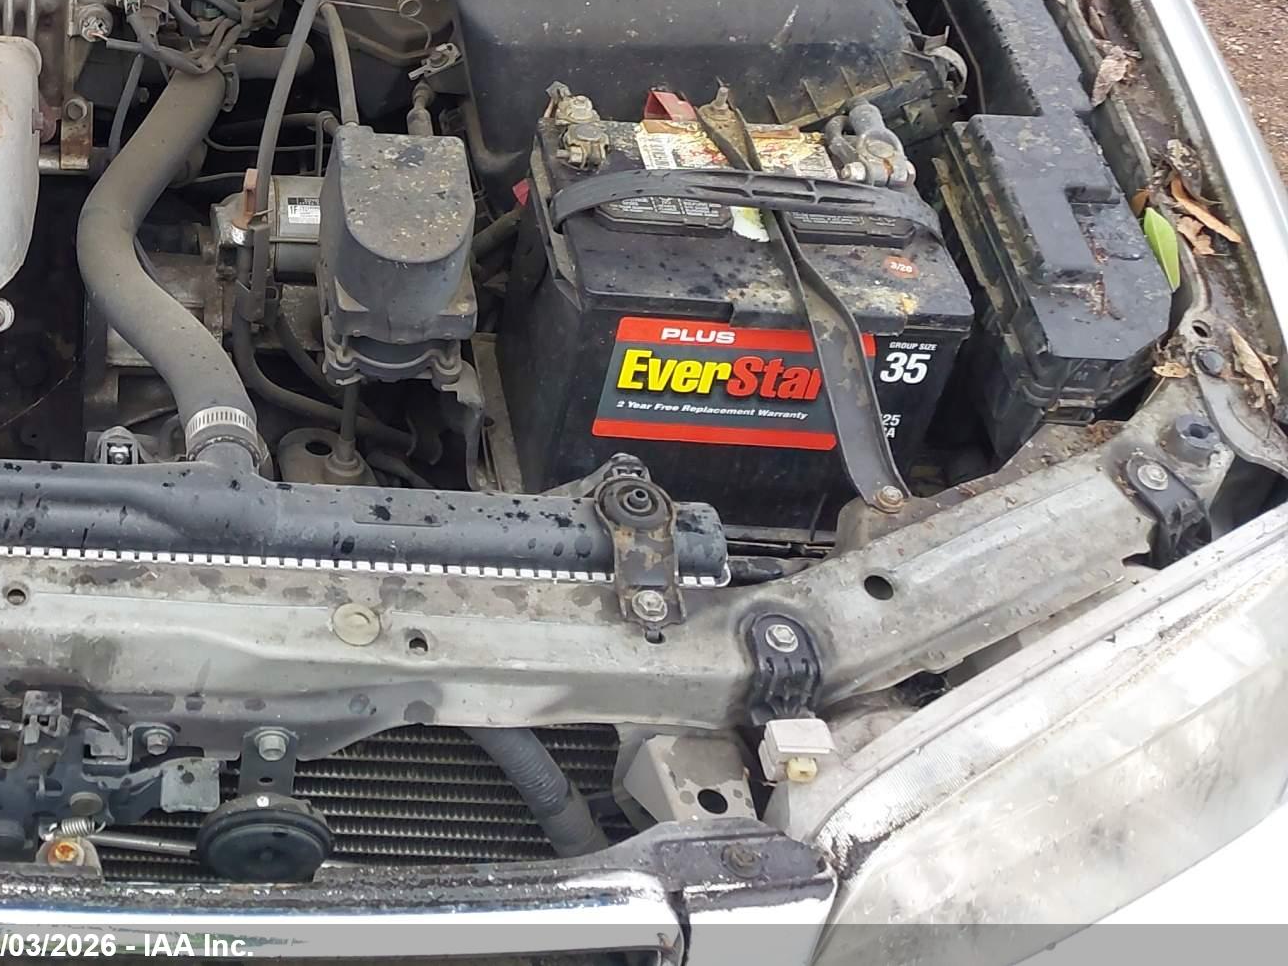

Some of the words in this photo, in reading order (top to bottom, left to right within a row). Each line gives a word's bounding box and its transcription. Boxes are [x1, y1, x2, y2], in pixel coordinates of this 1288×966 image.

[661, 327, 736, 344] PLUS
[889, 341, 918, 350] GROUP
[918, 343, 938, 351] SIZE
[879, 351, 931, 384] 35
[616, 400, 626, 408] 2
[628, 400, 652, 410] Year
[654, 403, 679, 411] Free
[681, 404, 755, 416] Replacement
[758, 409, 808, 420] Warranty
[881, 414, 902, 427] 25
